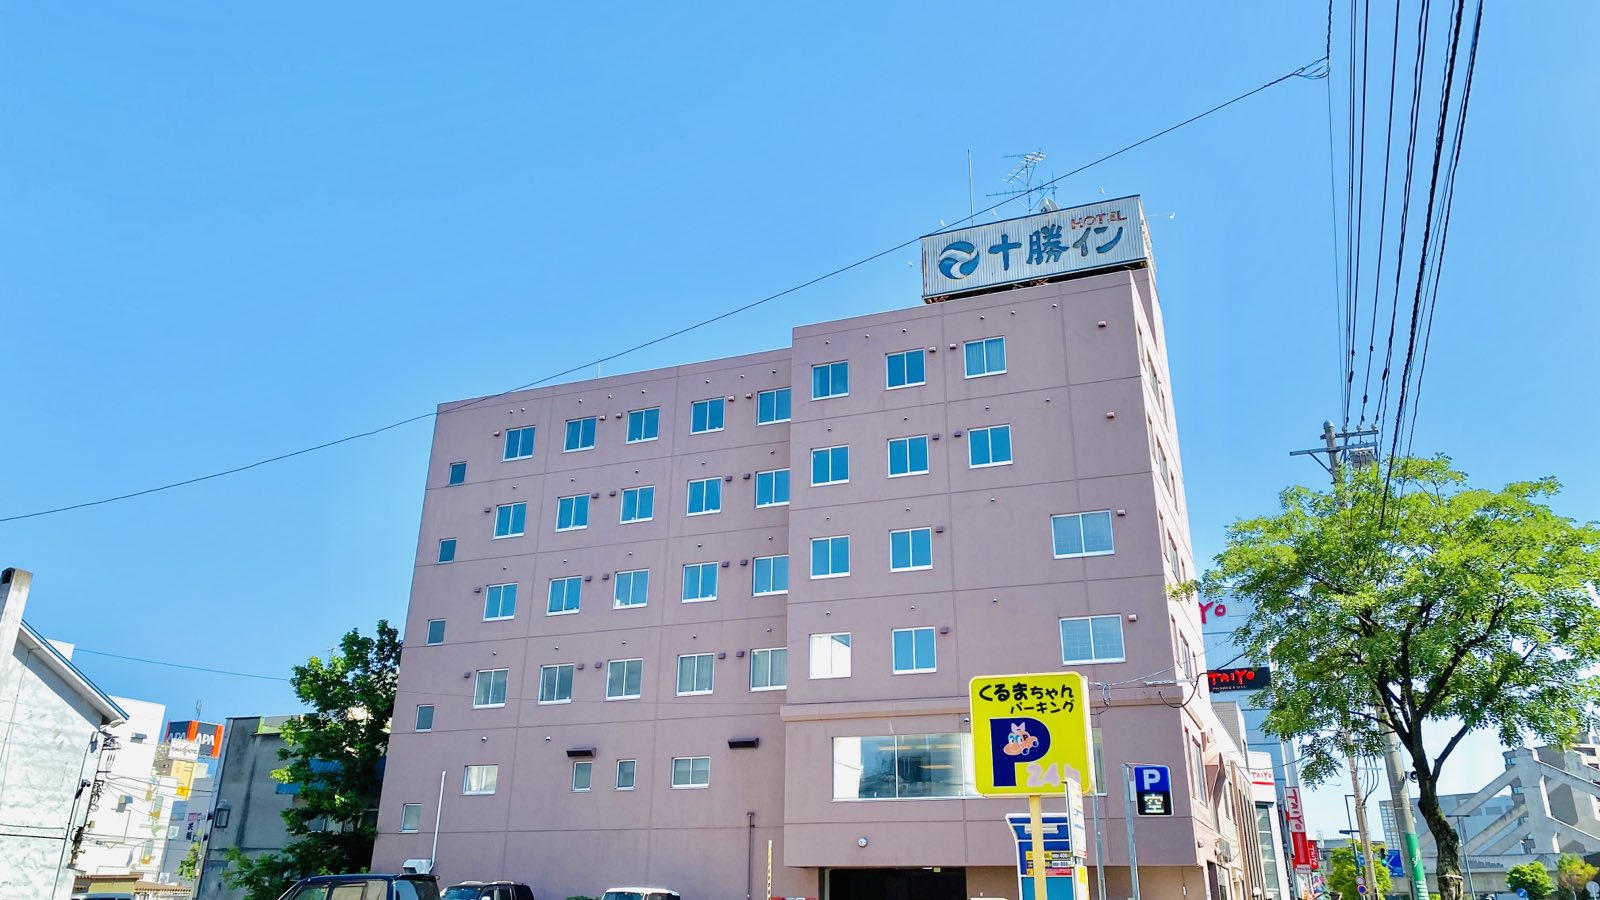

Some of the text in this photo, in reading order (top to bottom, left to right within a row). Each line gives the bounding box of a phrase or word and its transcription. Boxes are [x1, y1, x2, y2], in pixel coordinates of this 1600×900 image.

[1071, 210, 1127, 230] HOTEL
[988, 224, 1123, 271] 十勝イン
[1207, 669, 1255, 686] TAIYO
[979, 682, 1074, 702] くるまちゃん
[1010, 699, 1075, 714] パーキング
[195, 732, 215, 746] APA
[1143, 769, 1161, 790] P
[1251, 771, 1272, 781] TAIYO
[1144, 793, 1165, 813] 空
[1287, 788, 1303, 831] TAIYO
